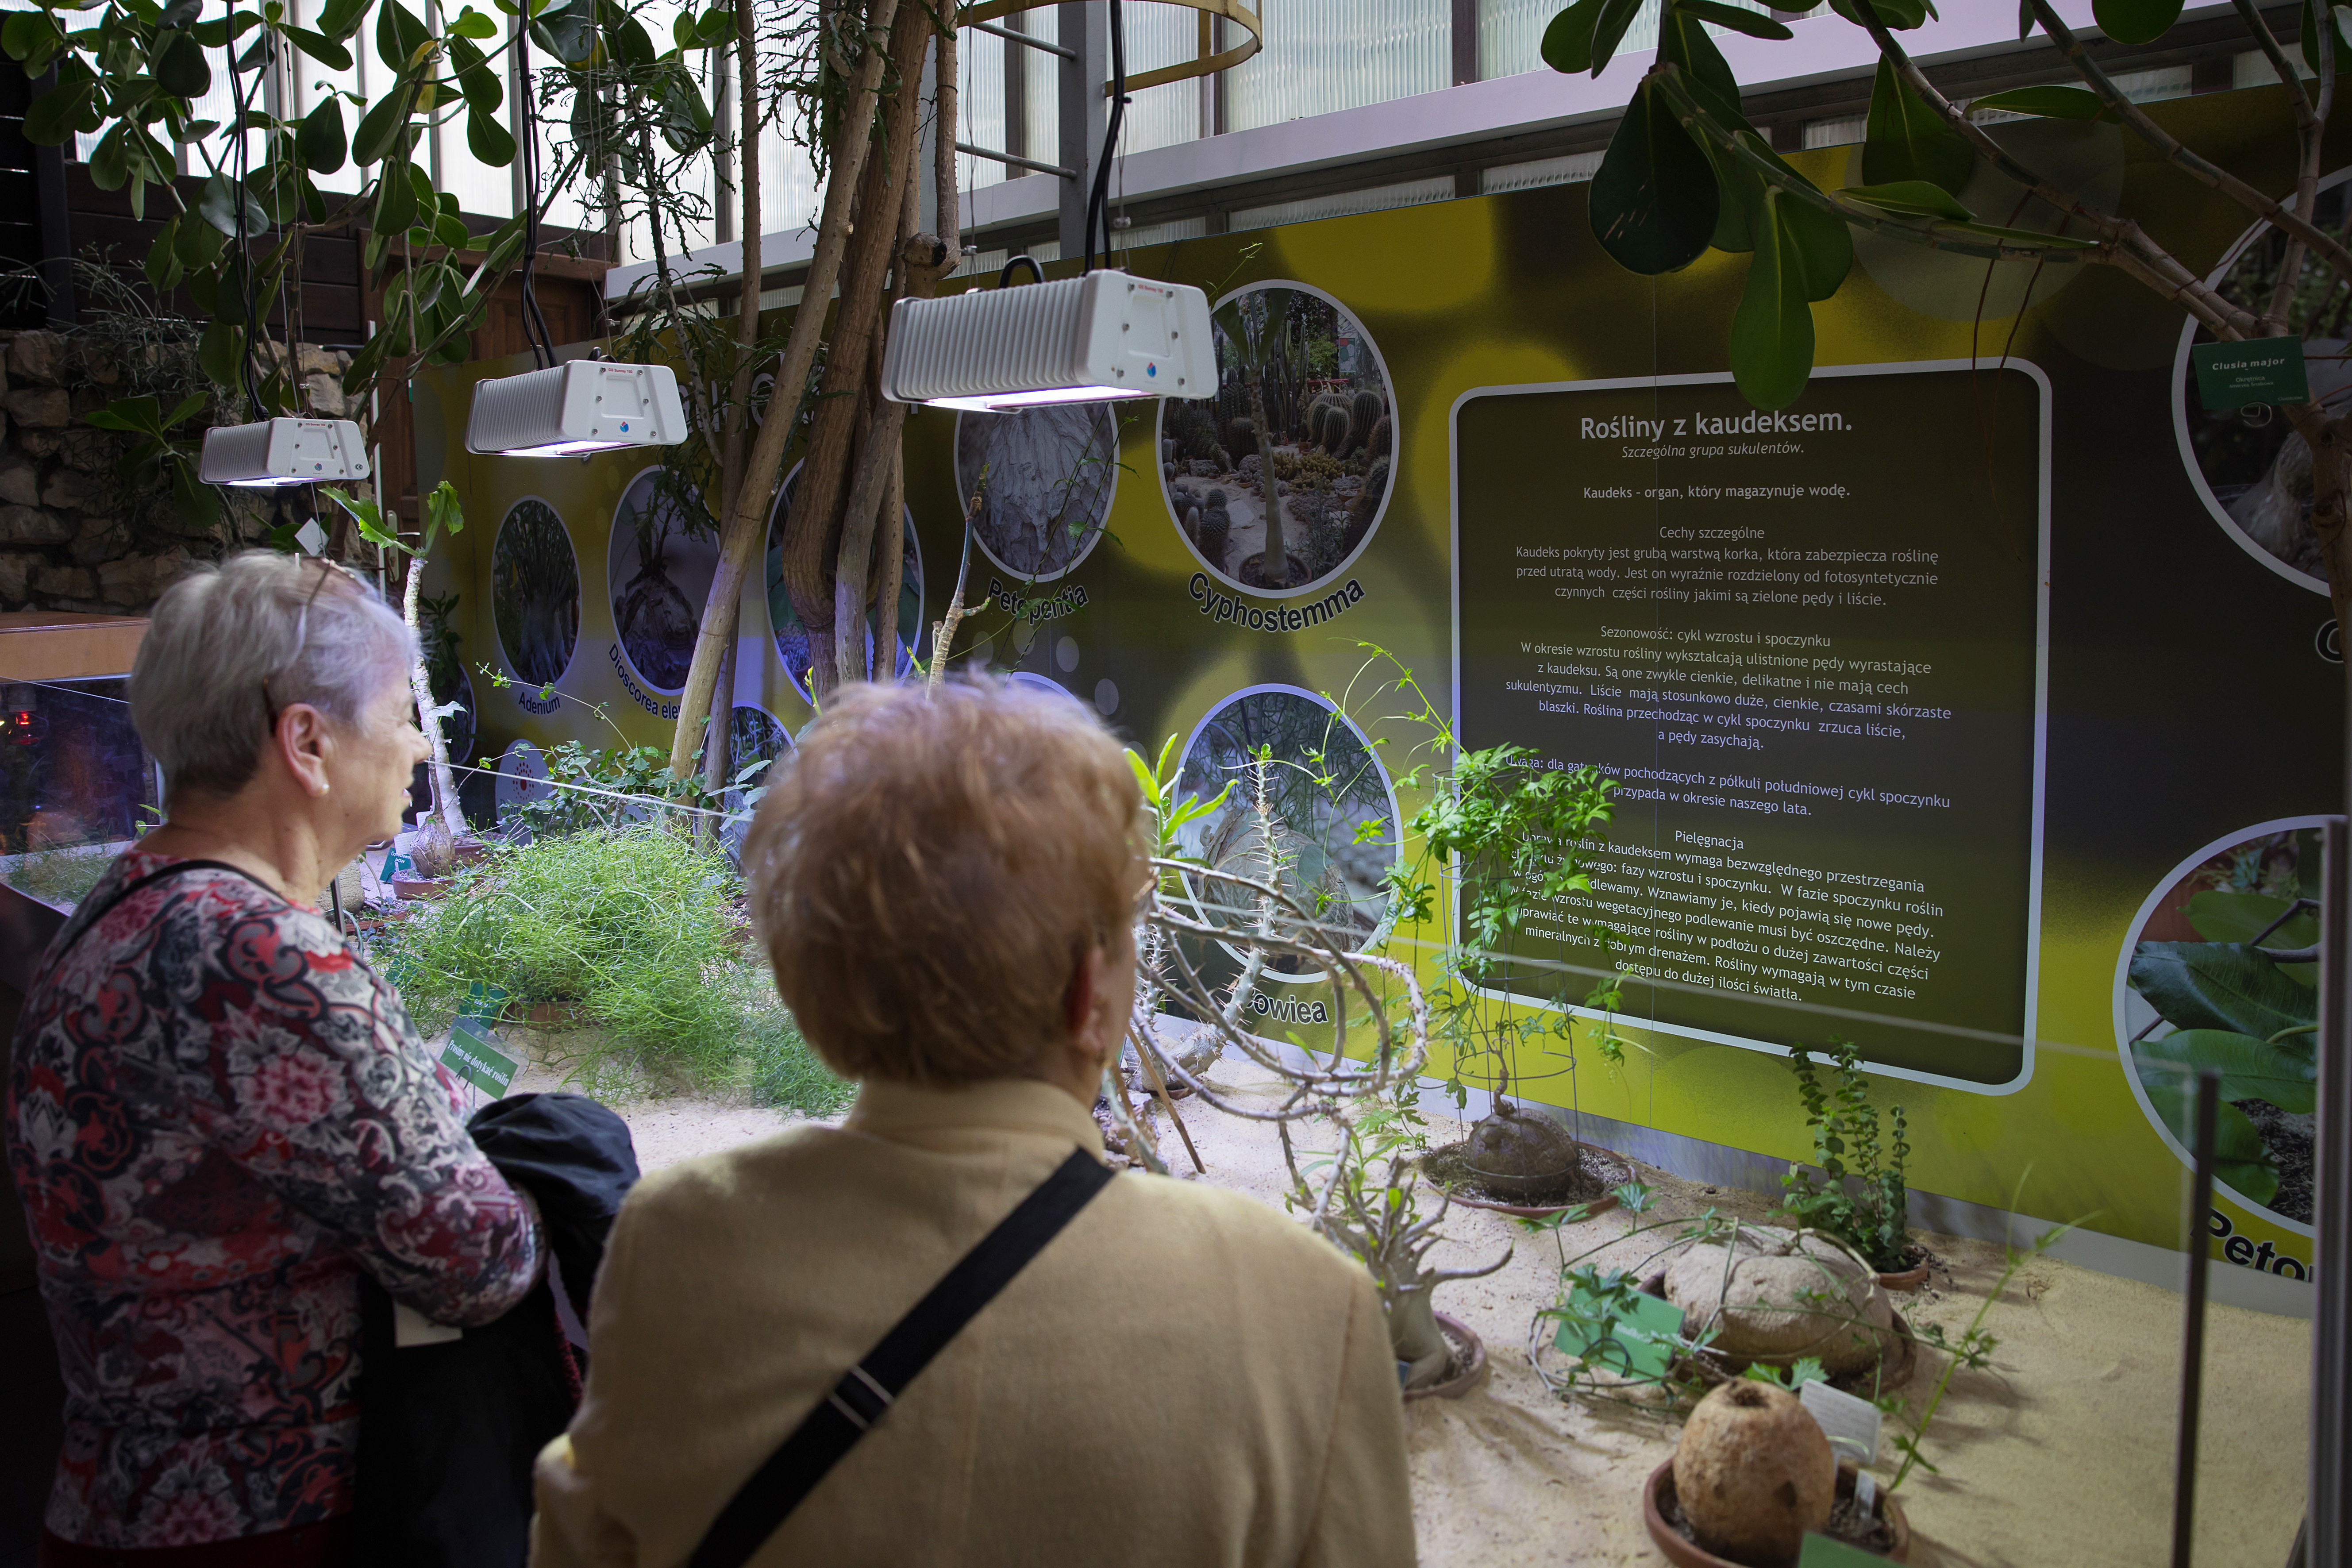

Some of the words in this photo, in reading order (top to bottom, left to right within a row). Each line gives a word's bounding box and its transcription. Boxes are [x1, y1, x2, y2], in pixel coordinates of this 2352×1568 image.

[2212, 361, 2247, 370] Clusia
[2250, 358, 2285, 368] major
[1581, 415, 1665, 443] Rośliny
[1696, 409, 1852, 435] kaudeksem.
[1622, 444, 1686, 460] Szczególna
[1689, 446, 1724, 459] grupa
[1728, 441, 1804, 455] sukulentów.
[1584, 486, 1632, 498] Kaudeks
[1644, 485, 1684, 501] organ,
[1688, 485, 1721, 500] który
[1725, 484, 1805, 500] magazynuje
[1809, 483, 1850, 499] wodę.
[1659, 526, 1695, 541] Cechy
[1698, 525, 1765, 542] szczególne
[1516, 546, 1560, 558] Kaudeks
[1563, 546, 1605, 561] pokryty
[1608, 547, 1630, 561] jest
[1633, 547, 1668, 562] grubą
[1670, 548, 1721, 562] warstwą
[1725, 547, 1763, 562] korka,
[1768, 547, 1802, 561] która
[1805, 548, 1887, 564] zabezpiecza
[1892, 548, 1939, 565] roślinę
[1517, 565, 1546, 579] przed
[1550, 566, 1585, 580] utratą
[1587, 566, 1620, 581] wody.
[1624, 567, 1648, 579] Jest
[1651, 570, 1666, 581] on
[1670, 567, 1724, 582] wyraźnie
[1728, 569, 1800, 585] rozdzielony
[1804, 570, 1820, 582] od
[1824, 570, 1938, 587] fotosyntetycznie
[1188, 571, 1366, 632] Cyphostemma
[1555, 586, 1605, 600] czynnych
[1612, 586, 1646, 601] części
[1651, 588, 1690, 603] rośliny
[1693, 589, 1731, 603] jakimi
[1735, 592, 1749, 604] są
[1752, 590, 1798, 603] zielone
[1802, 591, 1834, 607] pędy
[1847, 591, 1886, 605] liście.
[1601, 625, 1673, 640] Sezonowość:
[1677, 629, 1701, 643] cykl
[1705, 632, 1753, 643] wzrostu
[1765, 634, 1830, 648] spoczynku
[1534, 642, 1573, 655] okresie
[1576, 647, 1620, 658] wzrostu
[1624, 646, 1662, 663] rośliny
[1665, 649, 1743, 666] wykształcają
[1746, 652, 1809, 667] ulistnione
[1813, 656, 1844, 672] pędy
[1848, 660, 1932, 676] wyrastające
[608, 643, 659, 717] Dioscorea
[661, 701, 681, 720] ele
[1547, 662, 1601, 676] kaudeksu.
[1605, 665, 1619, 680] Są
[1621, 669, 1643, 679] one
[1646, 667, 1686, 683] zwykle
[1690, 670, 1737, 686] cienkie,
[1742, 673, 1802, 688] delikatne
[1814, 677, 1835, 690] nie
[1839, 679, 1874, 695] mają
[1877, 682, 1909, 694] cech
[518, 691, 561, 716] Adenium
[1506, 679, 1582, 695] sukulentyzmu.
[1590, 684, 1622, 697] Liście
[1629, 688, 1660, 702] mają
[1662, 690, 1731, 705] stosunkowo
[1734, 693, 1768, 709] duże,
[1773, 696, 1823, 713] cienkie,
[1829, 702, 1881, 715] czasami
[1886, 703, 1952, 719] skórzaste
[1539, 700, 1579, 714] blaszki.
[1584, 703, 1623, 717] Roślina
[1627, 708, 1699, 725] przechodząc
[1717, 713, 1741, 728] cykl
[1745, 717, 1809, 732] spoczynku
[1818, 723, 1861, 735] zrzuca
[1867, 723, 1905, 740] liście,
[1669, 730, 1697, 745] pędy
[1700, 734, 1764, 751] zasychają.
[1547, 758, 1564, 771] dla
[1624, 767, 1705, 786] pochodzących
[1719, 774, 1760, 790] półkuli
[1765, 779, 1843, 801] południowej
[1848, 787, 1875, 802] cykl
[1879, 792, 1950, 808] spoczynku
[1613, 786, 1666, 801] przypada
[1683, 791, 1725, 806] okresie
[1730, 798, 1778, 814] naszego
[1783, 801, 1811, 816] lata.
[1675, 830, 1744, 851] Pielęgnacja
[1608, 841, 1672, 861] kaudeksem
[1675, 852, 1723, 869] wymaga
[1727, 856, 1822, 882] bezwzględnego
[1827, 871, 1925, 893] przestrzegania
[1621, 863, 1645, 879] fazy
[1648, 868, 1694, 884] wzrostu
[1705, 876, 1771, 894] spoczynku.
[1797, 886, 1829, 902] fazie
[1832, 893, 1901, 911] spoczynku
[1905, 901, 1943, 917] roślin
[1551, 894, 1593, 909] wzrostu
[1596, 900, 1682, 924] wegetacyjnego
[1685, 913, 1754, 932] podlewanie
[1758, 925, 1787, 937] musi
[1791, 926, 1813, 942] być
[1817, 933, 1889, 953] oszczędne.
[1895, 942, 1941, 963] Należy
[1647, 885, 1718, 909] Wznawiamy
[1720, 896, 1737, 912] je,
[1742, 898, 1776, 918] kiedy
[1779, 906, 1831, 926] pojawią
[1833, 912, 1853, 929] się
[1856, 918, 1893, 932] nowe
[1896, 923, 1935, 940] pędy.
[1517, 907, 1564, 923] uprawiać
[1567, 913, 1580, 925] te
[1655, 927, 1694, 946] rośliny
[1711, 937, 1758, 953] podłożu
[1773, 945, 1808, 964] dużej
[1813, 953, 1883, 973] zawartości
[1887, 965, 1929, 980] części
[1525, 926, 1591, 946] mineralnych
[1648, 945, 1710, 966] drenażem.
[1715, 955, 1758, 976] Rośliny
[1761, 965, 1826, 987] wymagają
[1844, 977, 1870, 992] tym
[1874, 984, 1916, 999] czasie
[1615, 959, 1661, 978] dostępu
[1664, 967, 1678, 980] do
[1682, 970, 1714, 985] dużej
[1719, 976, 1750, 992] ilości
[1753, 981, 1802, 1002] światła.
[1247, 990, 1329, 1025] owiea
[447, 1039, 466, 1061] Prosimy
[463, 1051, 471, 1063] nie
[470, 1056, 494, 1077] dotykać
[492, 1068, 510, 1087] roślin
[2190, 1207, 2314, 1283] Peto
